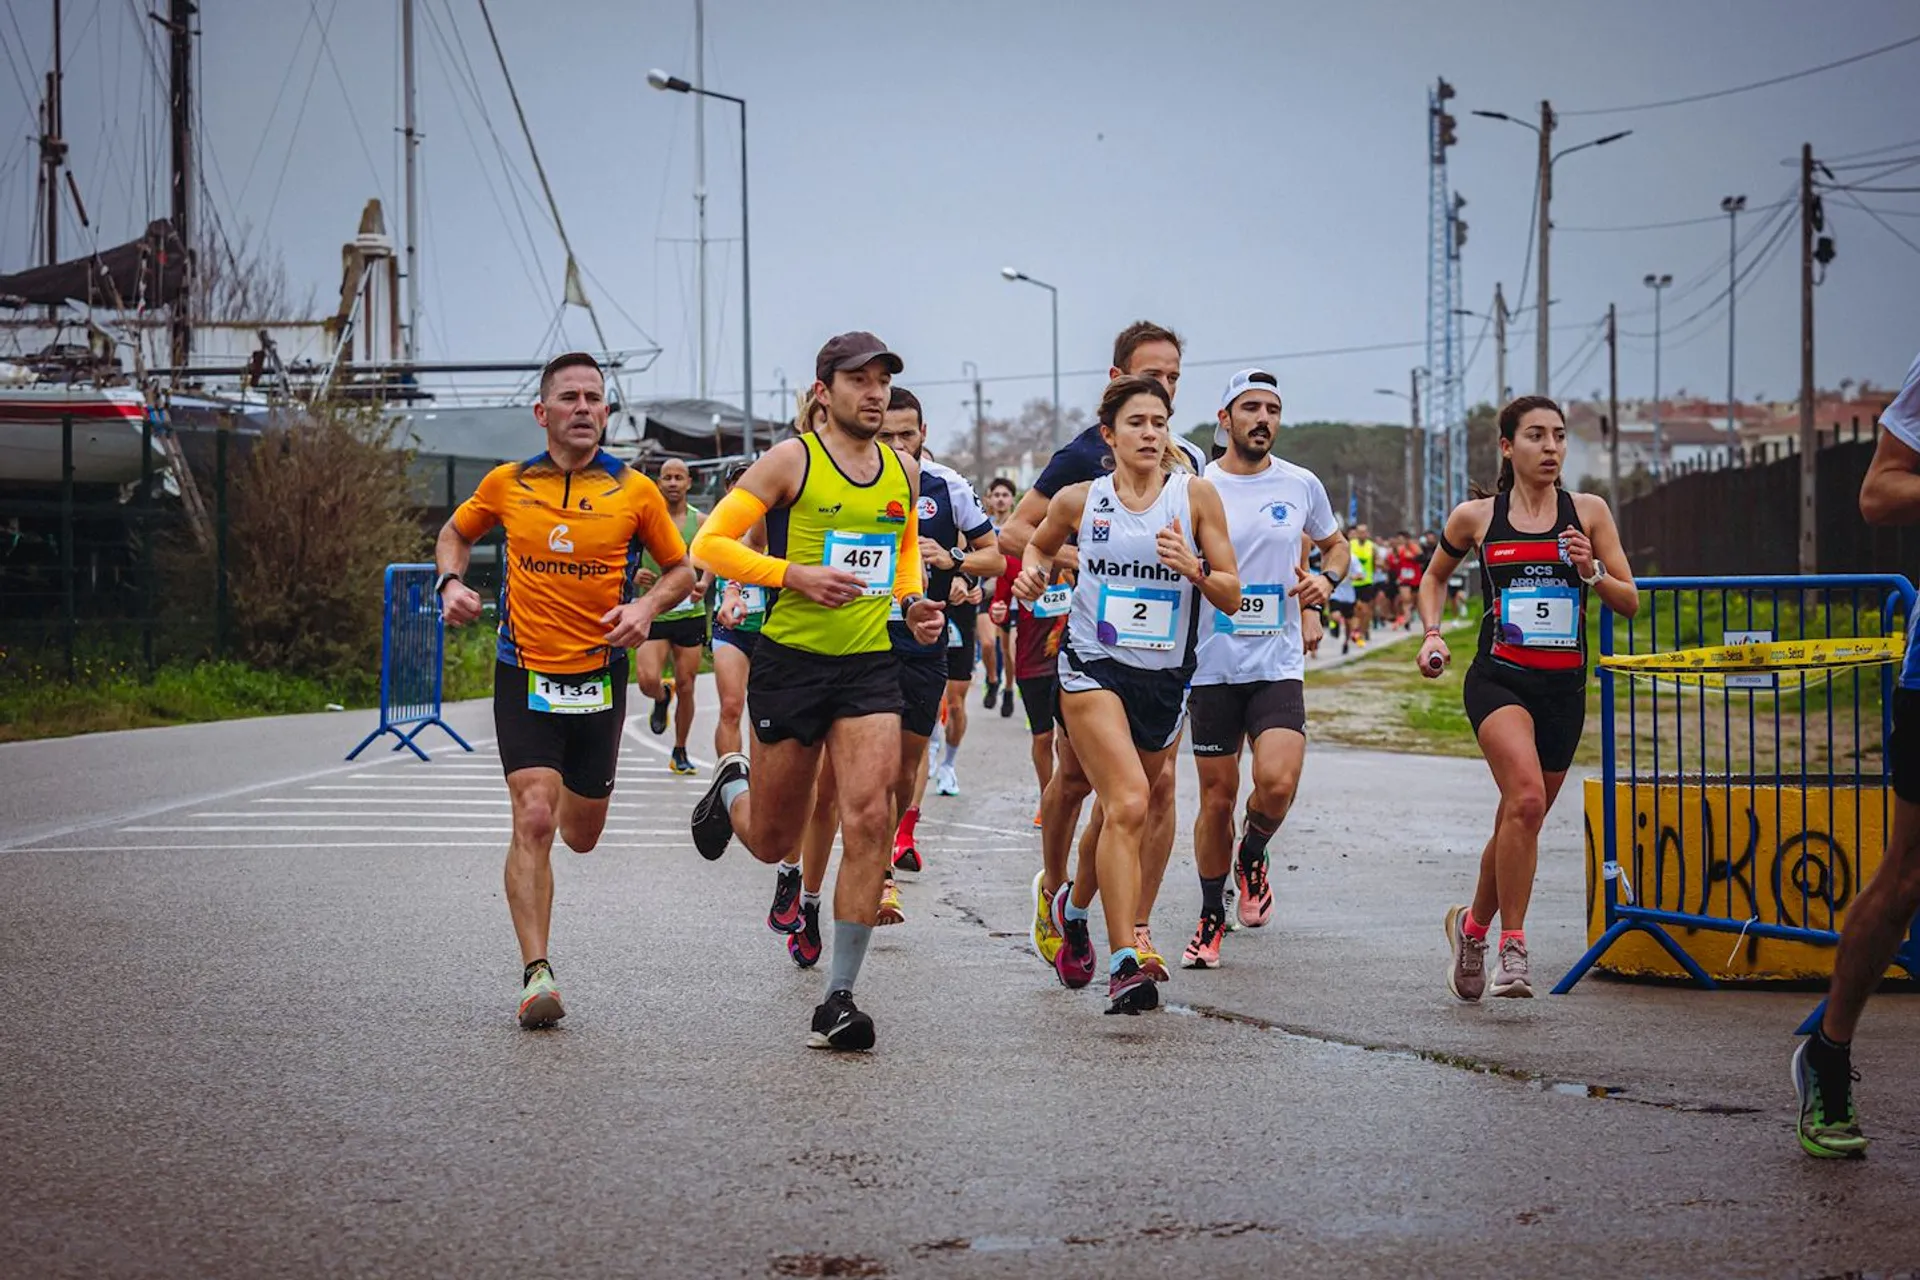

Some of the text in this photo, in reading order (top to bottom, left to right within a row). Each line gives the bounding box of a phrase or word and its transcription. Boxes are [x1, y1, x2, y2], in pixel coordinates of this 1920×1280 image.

[519, 554, 609, 580] Montepio
[844, 549, 883, 568] 467
[1088, 559, 1181, 582] Marinha
[1524, 565, 1553, 576] OCS
[1043, 592, 1067, 603] 628
[1240, 597, 1264, 612] 89
[1132, 602, 1148, 620] 2
[1536, 602, 1550, 619] 5
[541, 681, 598, 696] 1134
